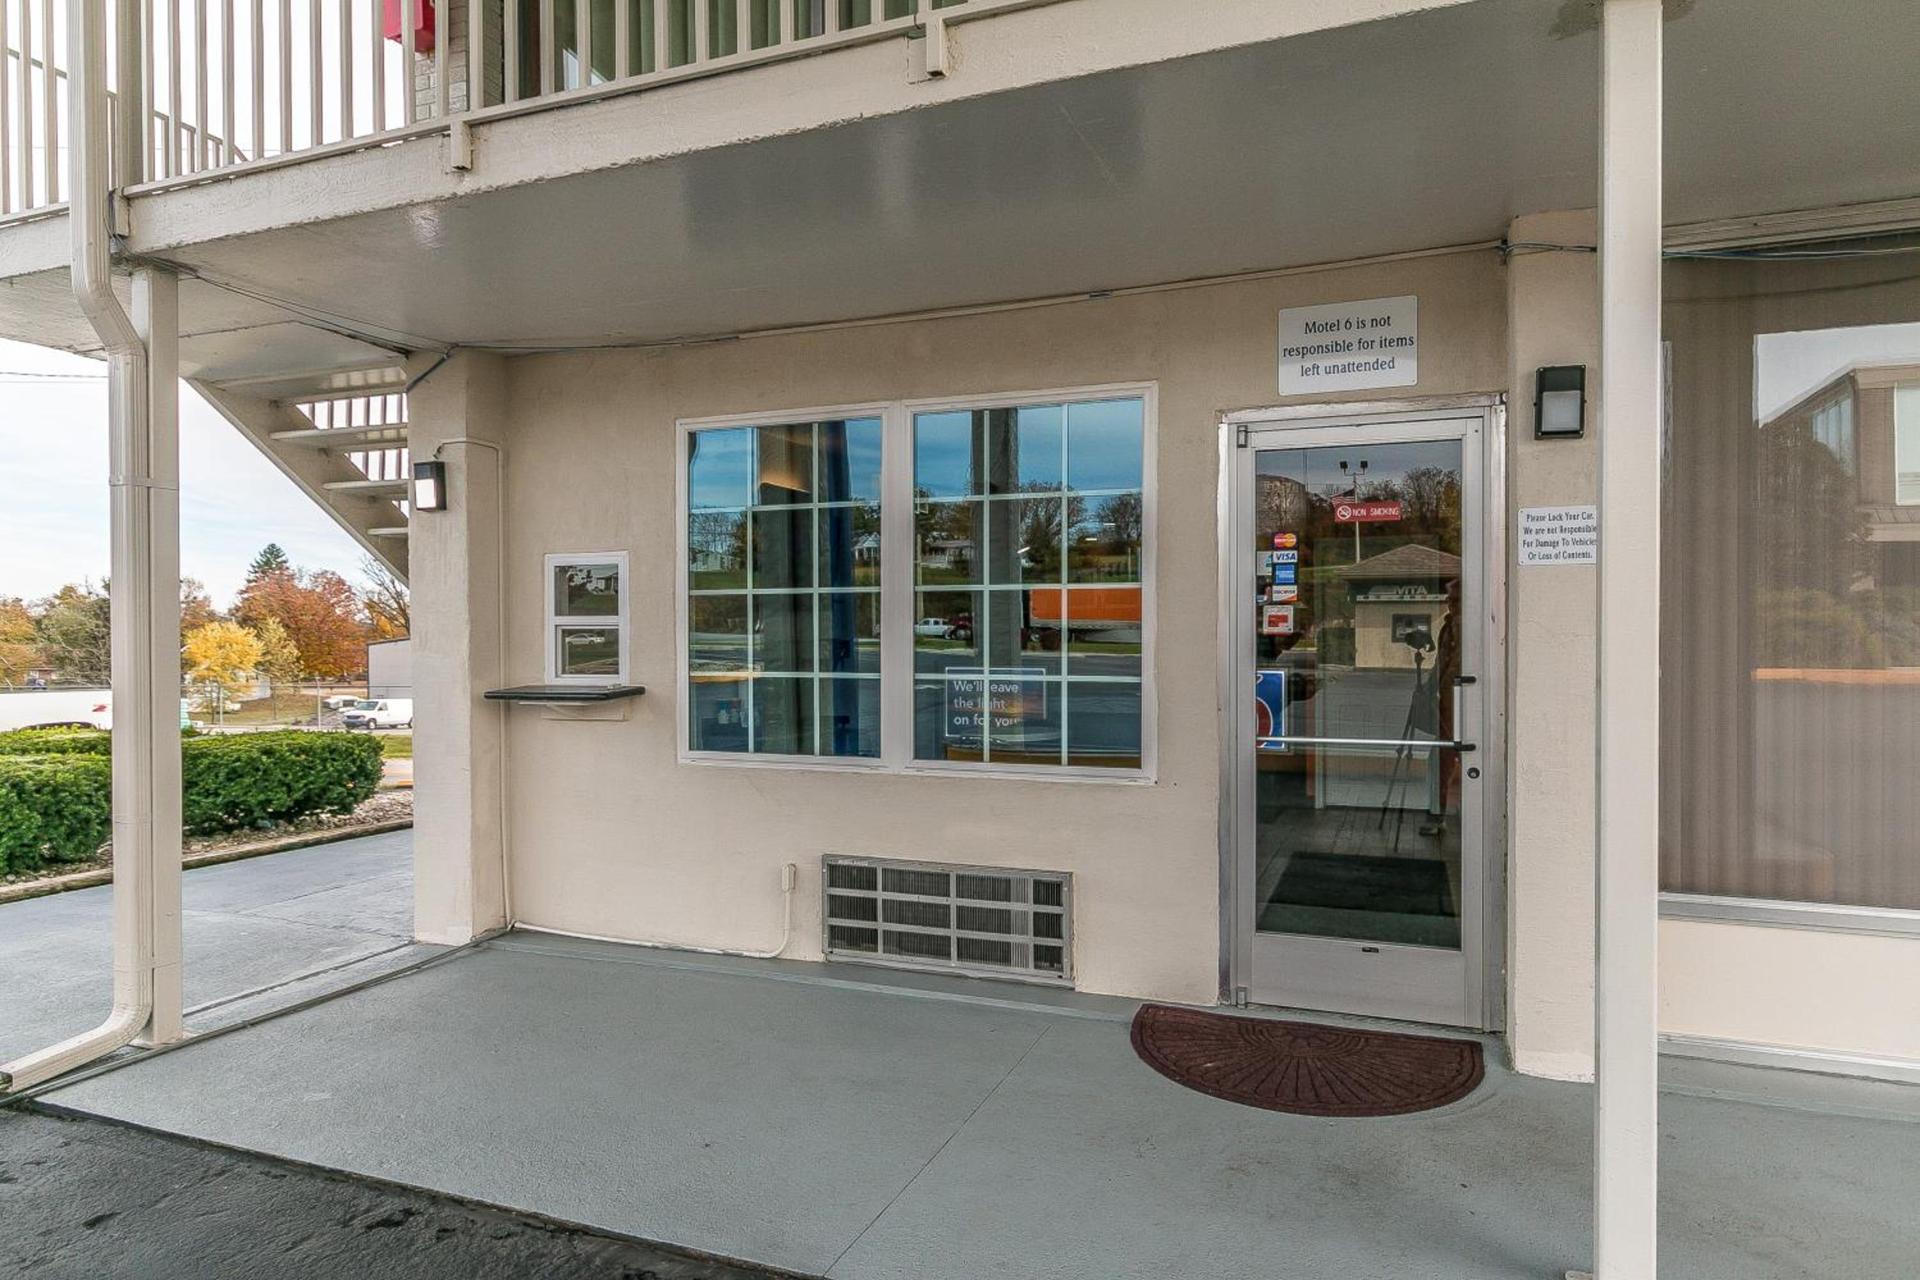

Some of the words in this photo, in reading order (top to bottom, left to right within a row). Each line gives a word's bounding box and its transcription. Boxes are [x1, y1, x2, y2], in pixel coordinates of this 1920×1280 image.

[1304, 319, 1340, 335] Motel
[1344, 317, 1353, 331] 6
[1356, 316, 1367, 330] is
[1370, 315, 1392, 329] not
[1283, 340, 1354, 359] responsible
[1358, 337, 1376, 352] for
[1379, 335, 1415, 349] items
[1300, 363, 1321, 377] left
[1324, 356, 1396, 375] unattended
[1352, 508, 1367, 517] NON
[1369, 507, 1400, 516] SMOKING
[1526, 513, 1546, 522] Please
[1548, 512, 1563, 521] Lock
[1565, 511, 1580, 520] Your
[1581, 511, 1595, 520] Car.
[1523, 526, 1533, 535] We
[1535, 527, 1546, 535] are
[1547, 526, 1558, 534] not
[1522, 539, 1533, 548] For
[1535, 538, 1559, 549] Damage
[1561, 537, 1570, 546] To
[1275, 552, 1297, 561] VISA
[1527, 551, 1537, 560] Or
[1538, 551, 1553, 560] Loss
[1554, 550, 1561, 559] of
[953, 679, 983, 692] We'll
[990, 683, 1019, 693] eave
[953, 696, 974, 709] the
[978, 697, 1006, 711] liht
[953, 716, 969, 725] on
[974, 714, 992, 726] fo
